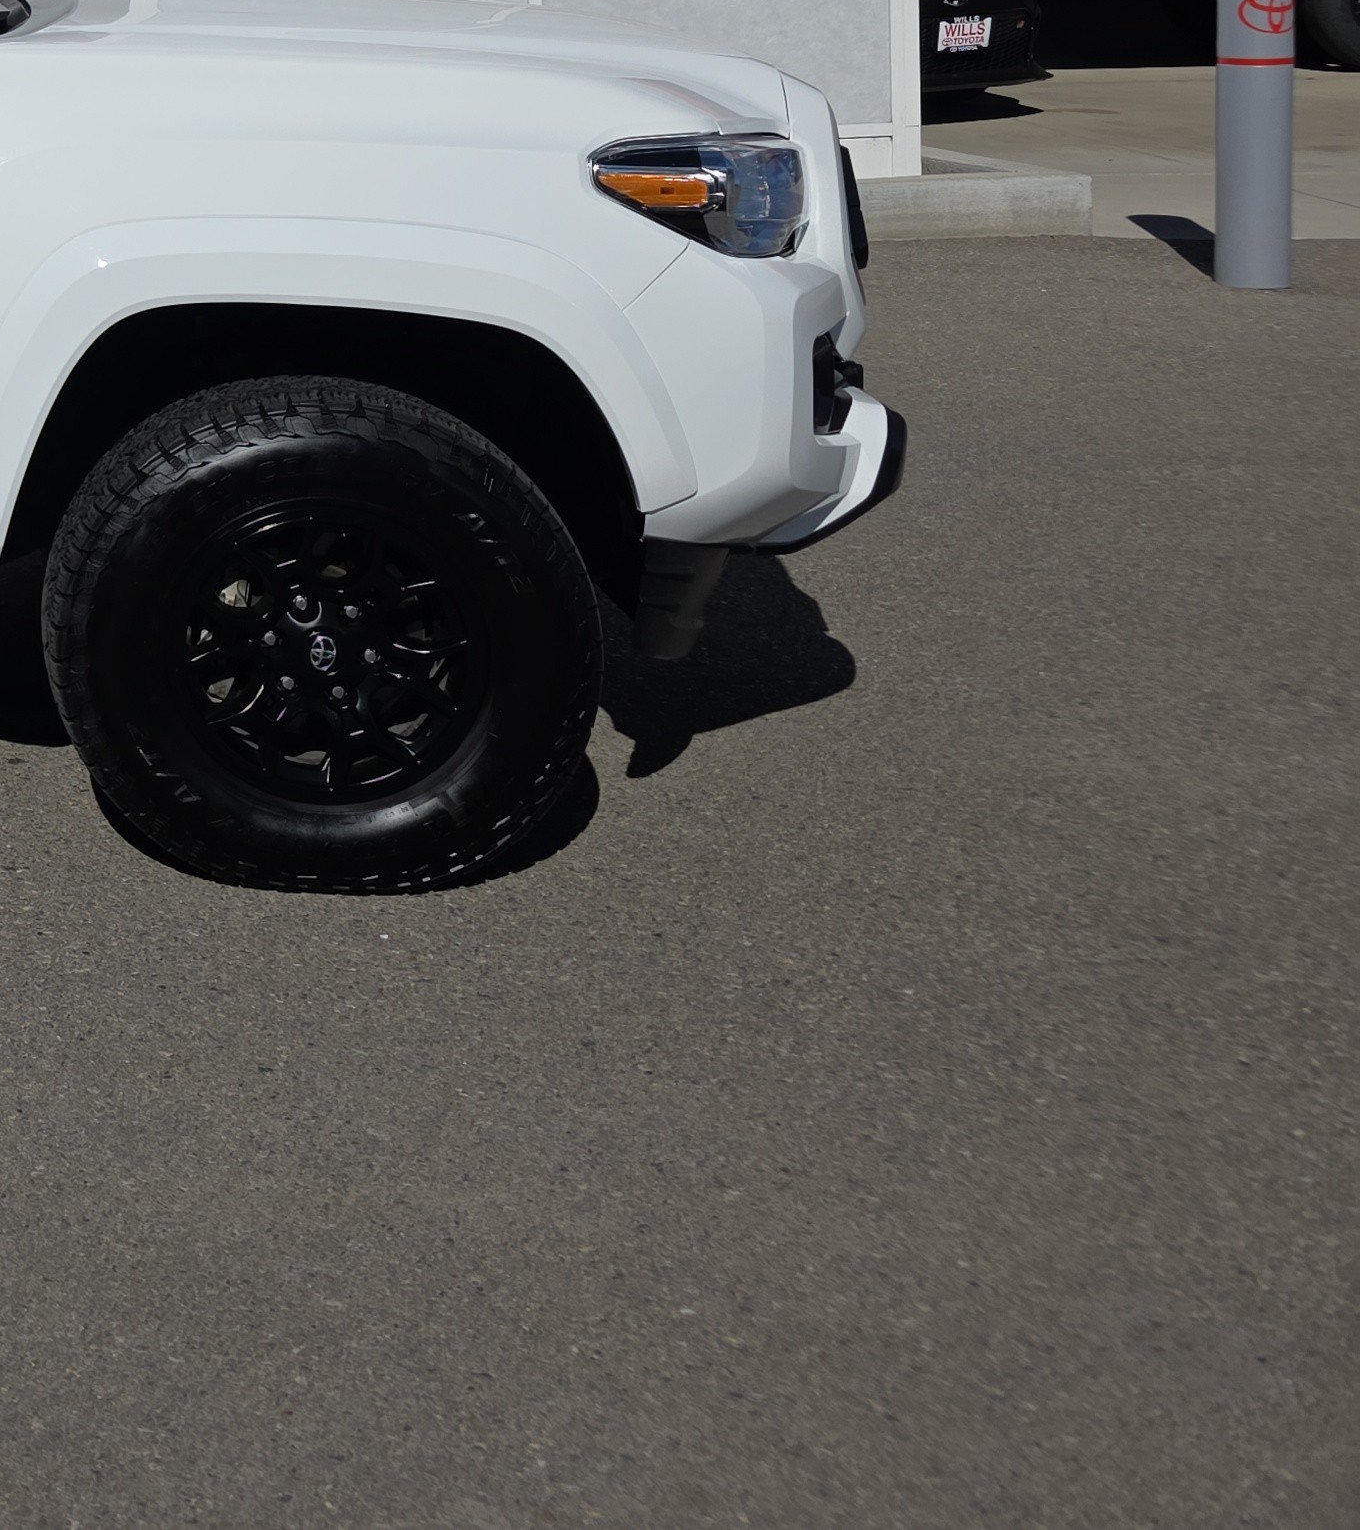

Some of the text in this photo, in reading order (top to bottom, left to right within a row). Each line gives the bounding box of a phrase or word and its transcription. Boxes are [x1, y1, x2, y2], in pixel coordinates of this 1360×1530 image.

[954, 15, 980, 23] WILLS
[945, 22, 985, 37] WILLS
[954, 36, 984, 45] TOYOTA
